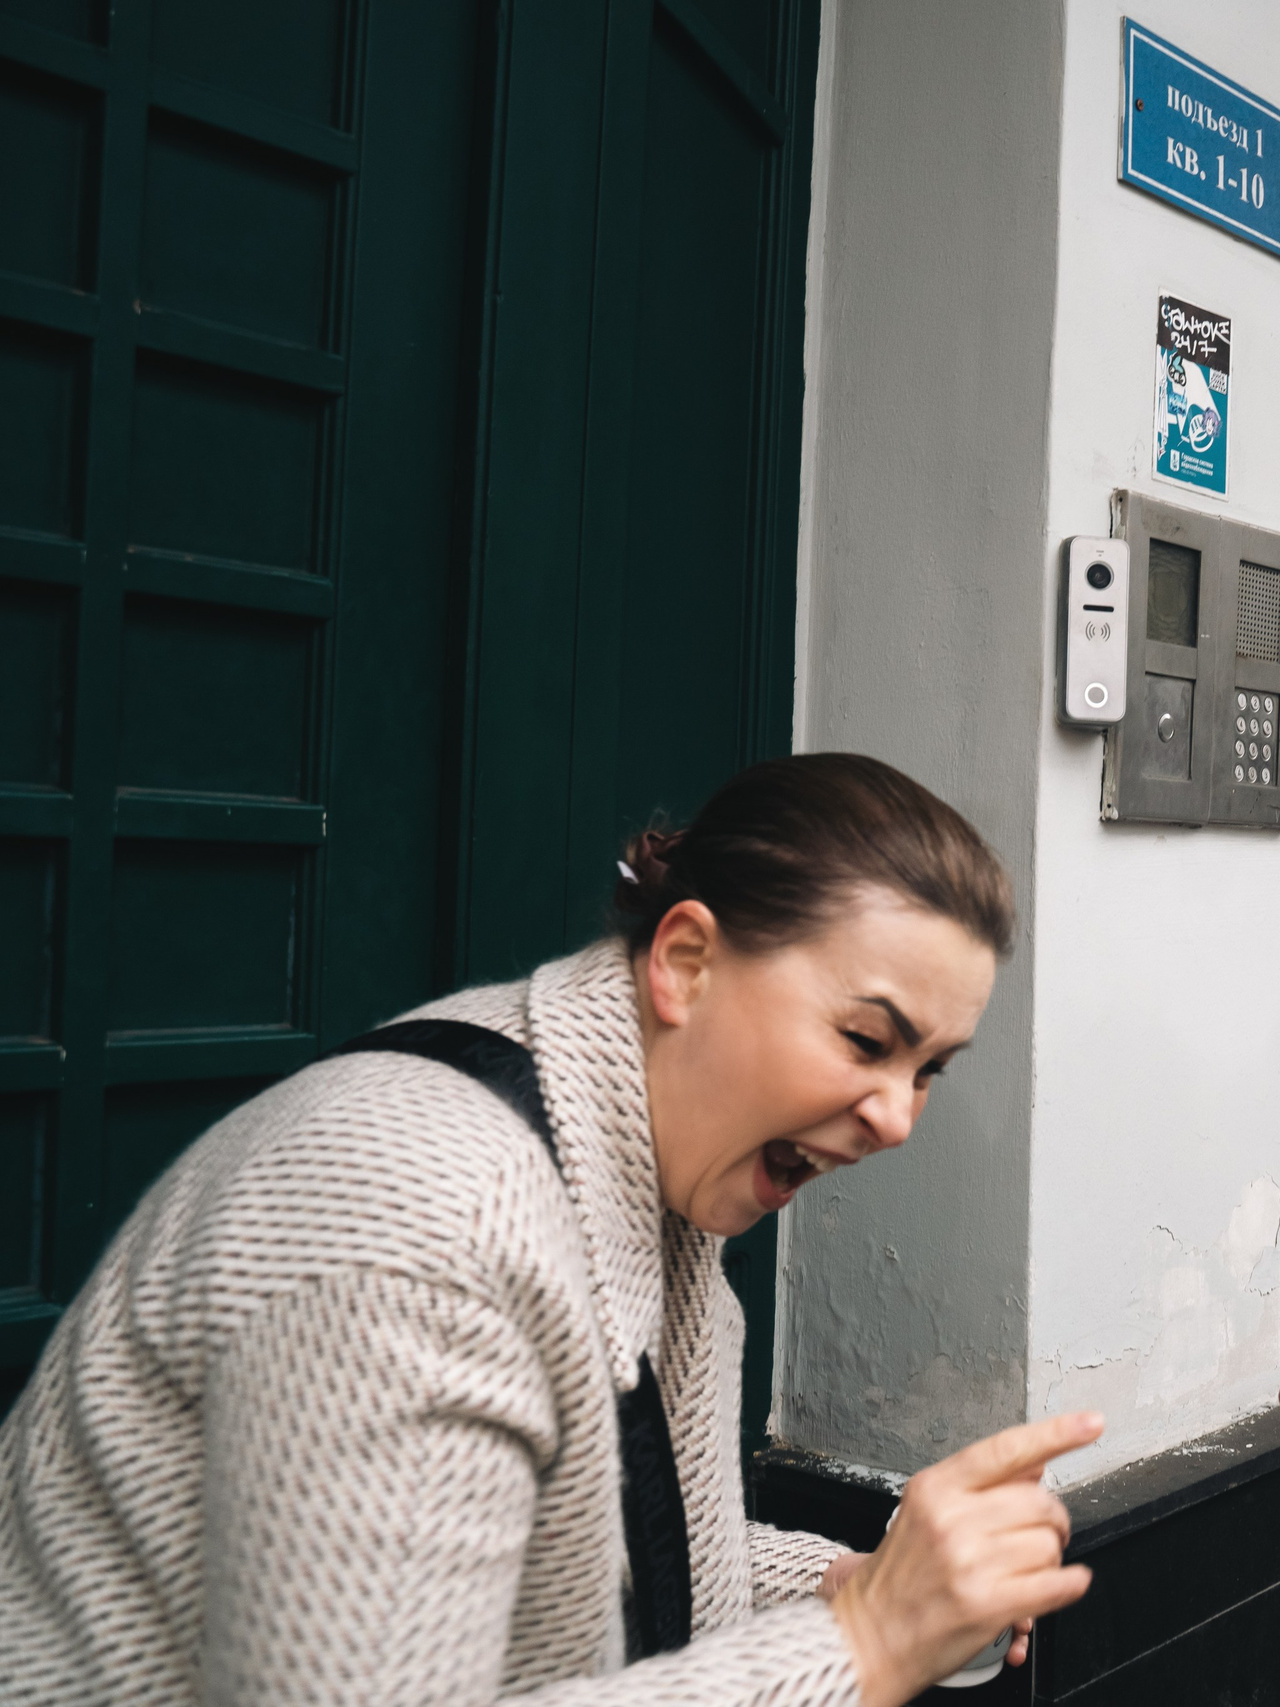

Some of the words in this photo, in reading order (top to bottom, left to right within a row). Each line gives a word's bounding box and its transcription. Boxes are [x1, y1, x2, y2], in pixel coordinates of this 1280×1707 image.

[1255, 129, 1263, 158] 1
[1216, 155, 1265, 210] 1-10
[1171, 332, 1218, 358] 24/7
[627, 1418, 668, 1540] KARL
